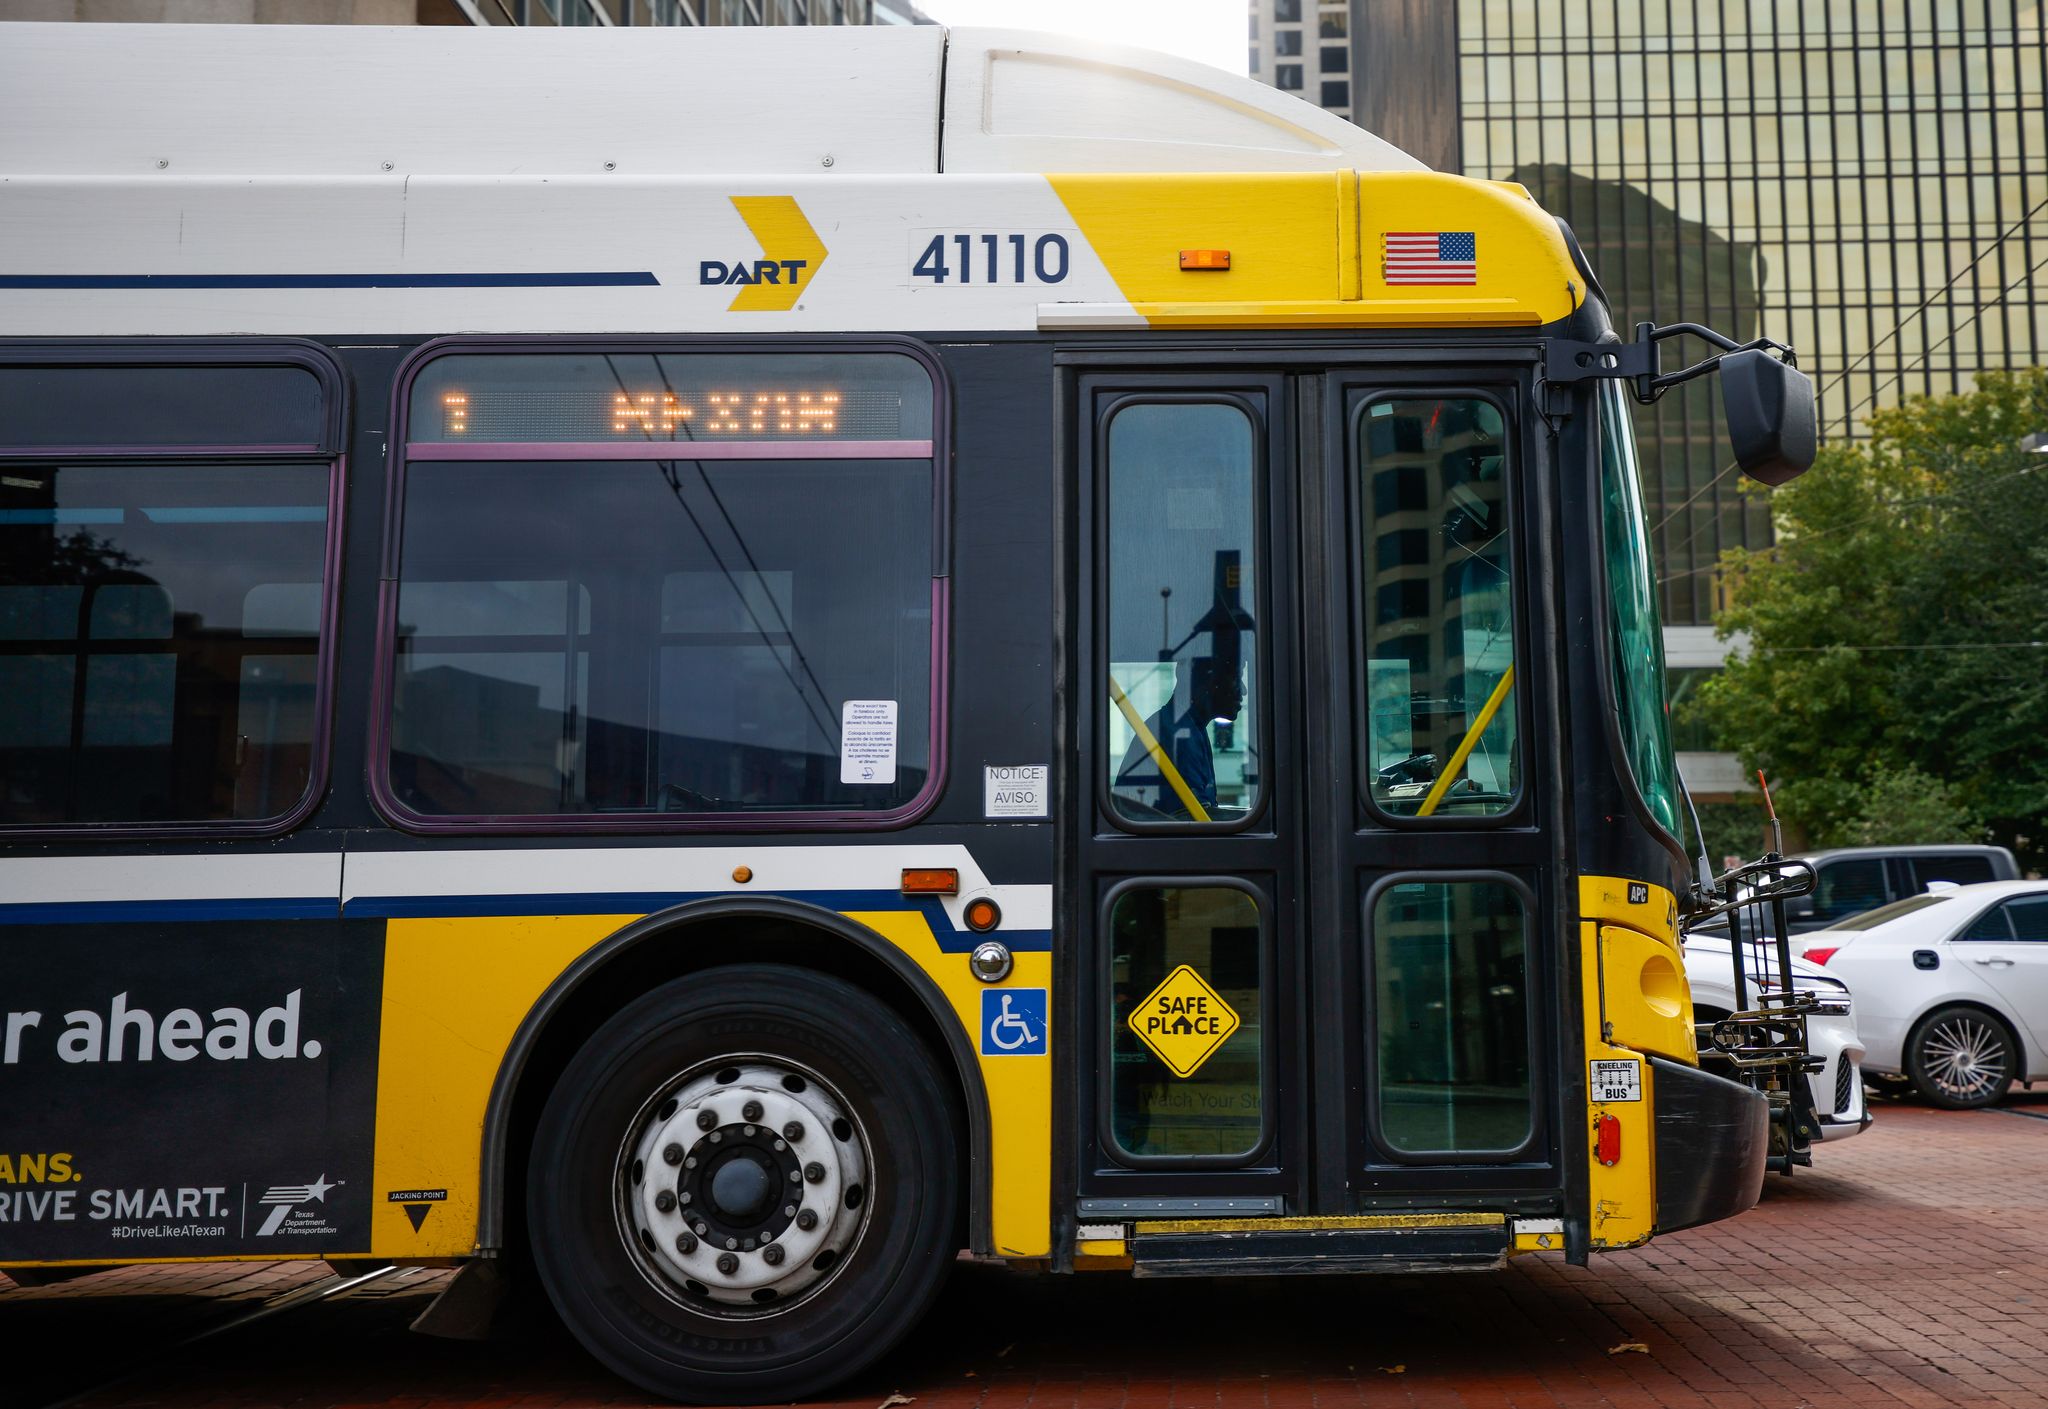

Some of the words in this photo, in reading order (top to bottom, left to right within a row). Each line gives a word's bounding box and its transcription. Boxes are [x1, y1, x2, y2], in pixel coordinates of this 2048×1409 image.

[912, 233, 1068, 283] 41110
[700, 260, 806, 285] DART
[990, 768, 1043, 779] NOTICE:
[995, 792, 1037, 803] AVISO:
[1631, 887, 1646, 902] APC
[1158, 996, 1207, 1014] SAFE
[57, 988, 322, 1063] ahead.
[1142, 1091, 1192, 1107] Watch
[1199, 1092, 1234, 1108] Your
[1606, 1088, 1627, 1098] BUS
[88, 1187, 228, 1220] SMART.
[285, 1219, 325, 1227] Department
[112, 1226, 225, 1238] #DriveLikeATexan
[288, 1227, 337, 1235] Transportation
